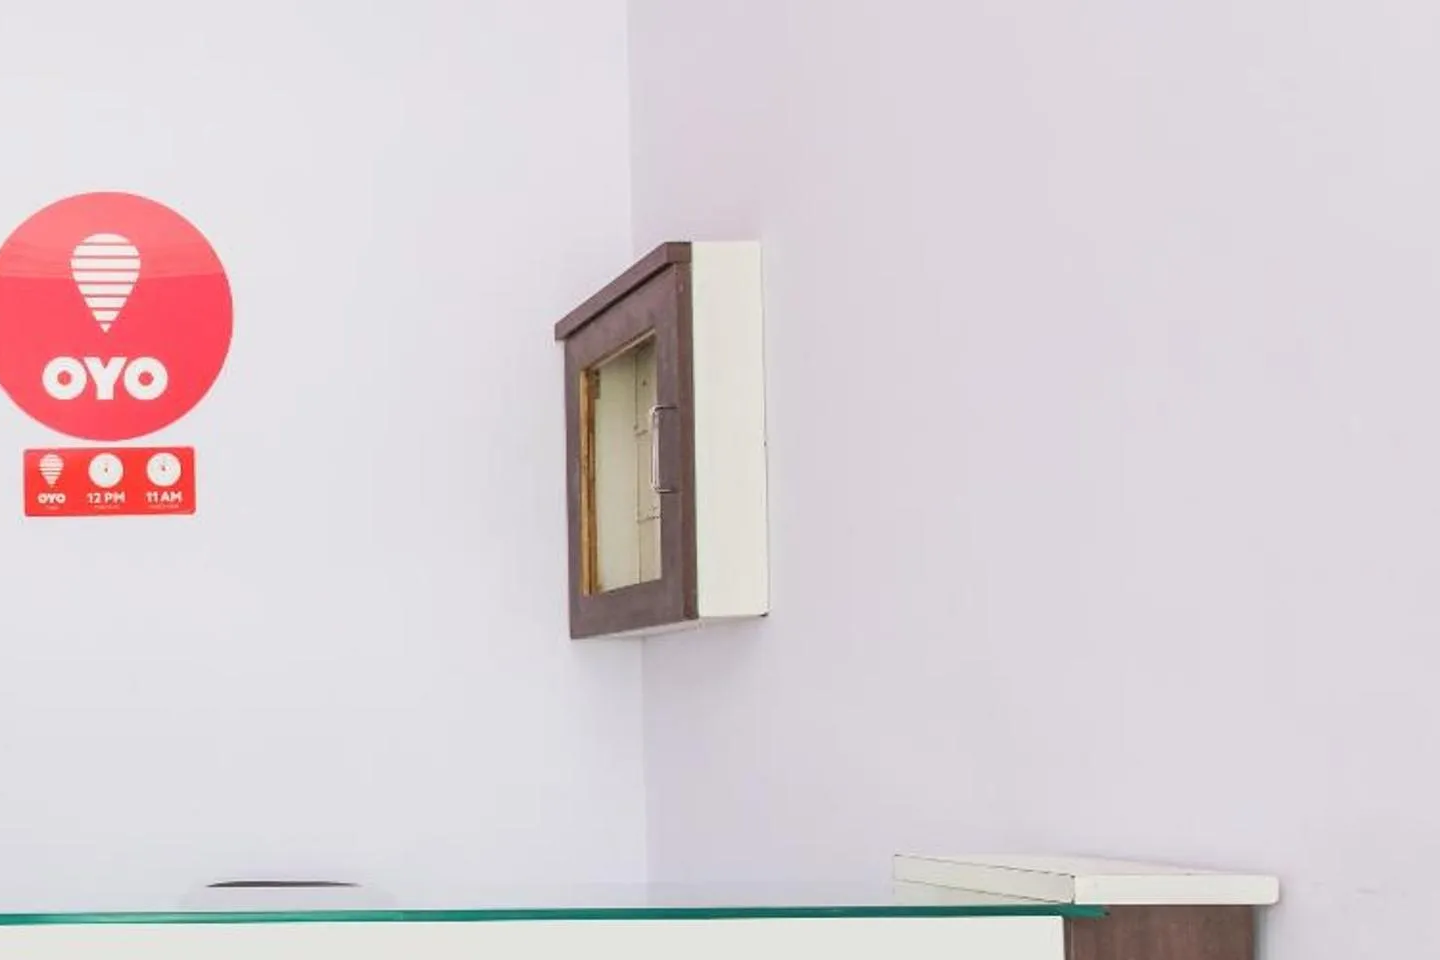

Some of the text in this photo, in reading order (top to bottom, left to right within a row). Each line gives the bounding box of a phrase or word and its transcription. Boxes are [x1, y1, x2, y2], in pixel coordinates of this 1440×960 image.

[42, 356, 168, 400] OYO
[38, 492, 66, 504] OYO
[87, 492, 125, 504] 12 PM
[146, 491, 182, 503] 11 AM
